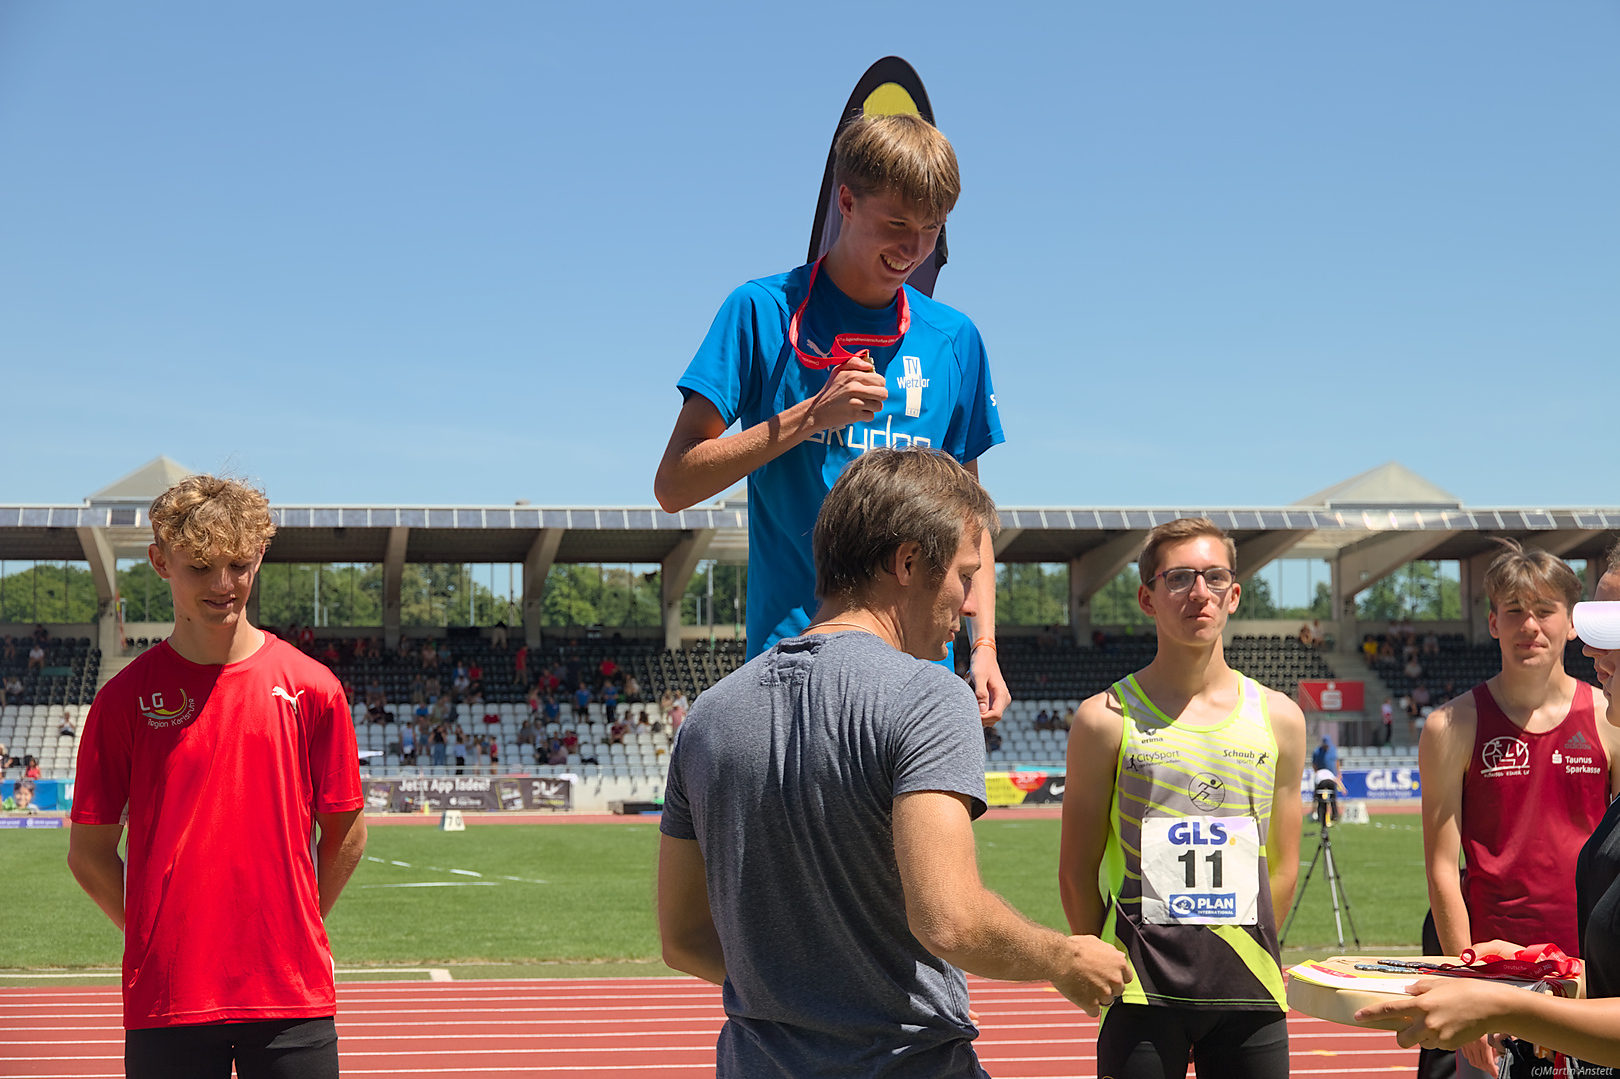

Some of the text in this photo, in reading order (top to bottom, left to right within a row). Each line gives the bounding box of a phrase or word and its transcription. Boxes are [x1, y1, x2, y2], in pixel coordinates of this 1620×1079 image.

[905, 358, 919, 375] TV
[897, 376, 930, 389] Wetzlar
[138, 692, 164, 711] LG
[171, 698, 195, 727] Karlsruhe
[1136, 750, 1180, 763] CitySport
[1222, 749, 1255, 759] Schaub
[1565, 755, 1593, 764] Taunus
[1565, 764, 1601, 774] Sparkasse
[430, 779, 453, 794] App
[455, 778, 490, 792] laden!
[1178, 849, 1222, 888] 11
[1197, 898, 1233, 909] PLAN
